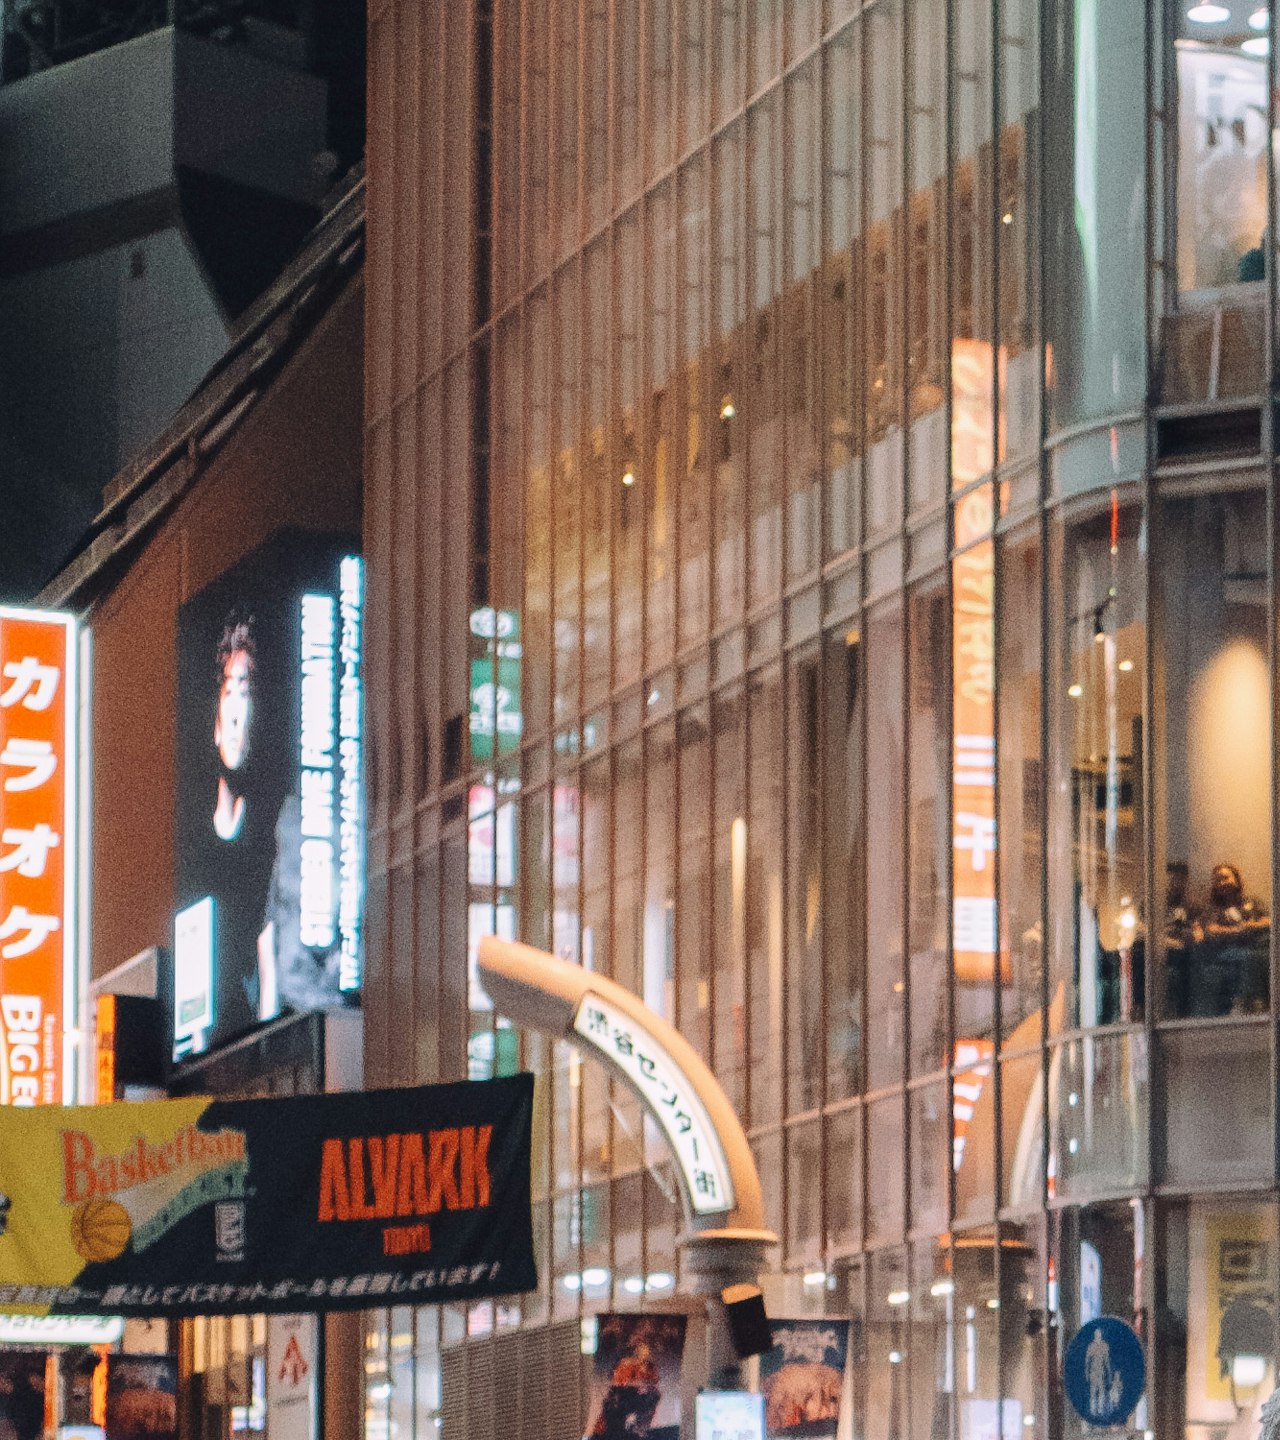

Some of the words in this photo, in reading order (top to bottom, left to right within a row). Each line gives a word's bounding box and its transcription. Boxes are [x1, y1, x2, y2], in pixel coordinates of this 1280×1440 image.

[1, 657, 60, 959] カラオケ
[1, 994, 42, 1072] BIG
[318, 1125, 494, 1223] ALVARK
